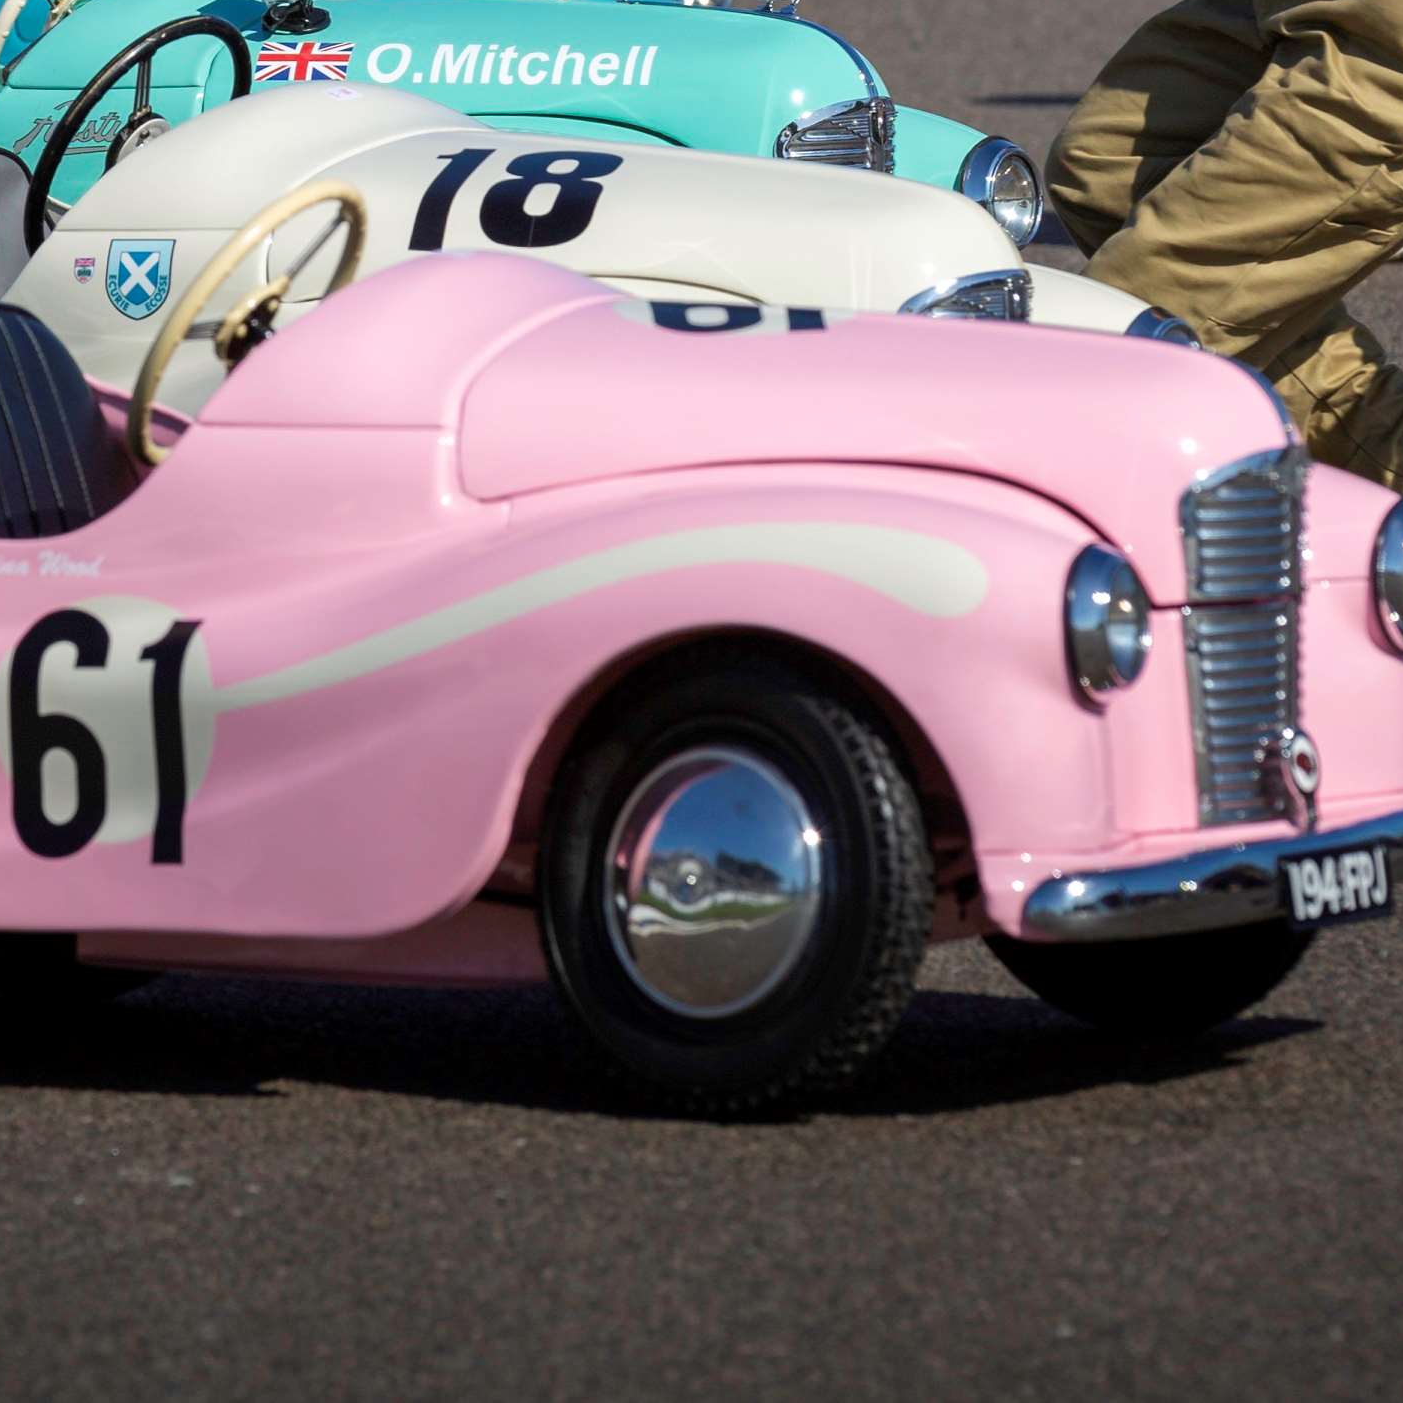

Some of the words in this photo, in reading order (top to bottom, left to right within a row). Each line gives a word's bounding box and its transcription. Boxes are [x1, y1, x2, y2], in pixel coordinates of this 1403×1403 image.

[366, 43, 658, 85] O.Mitchell
[408, 148, 624, 252] 18
[108, 274, 131, 312] ECURIE
[144, 274, 168, 312] ECOSSE
[9, 609, 204, 865] 61
